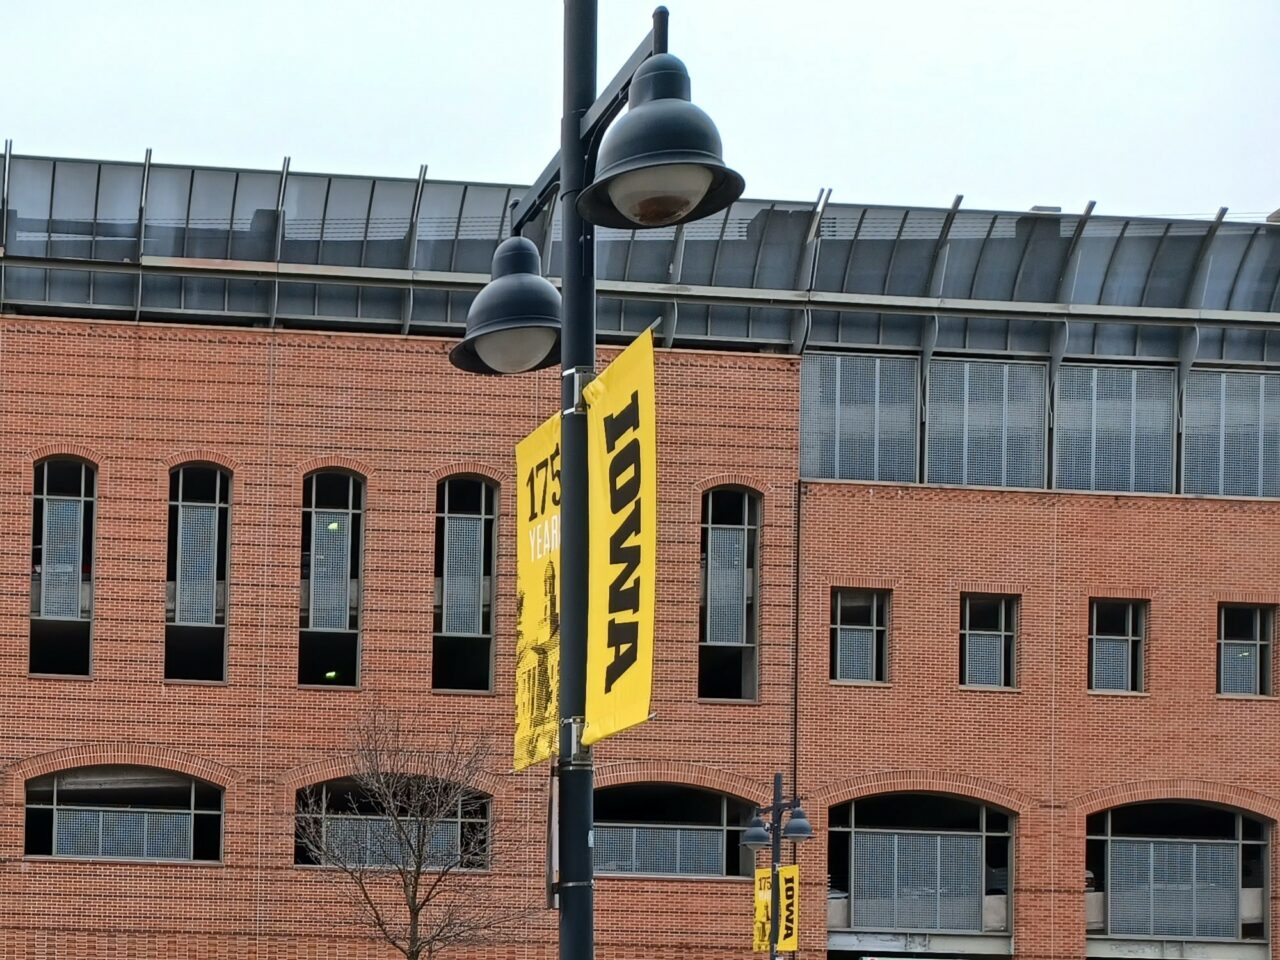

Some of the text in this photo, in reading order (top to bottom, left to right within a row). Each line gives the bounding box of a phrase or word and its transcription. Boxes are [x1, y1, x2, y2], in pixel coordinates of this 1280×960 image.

[526, 442, 561, 522] 175
[529, 514, 561, 562] YEAR
[604, 390, 641, 694] IOWA
[783, 876, 795, 940] IOWA
